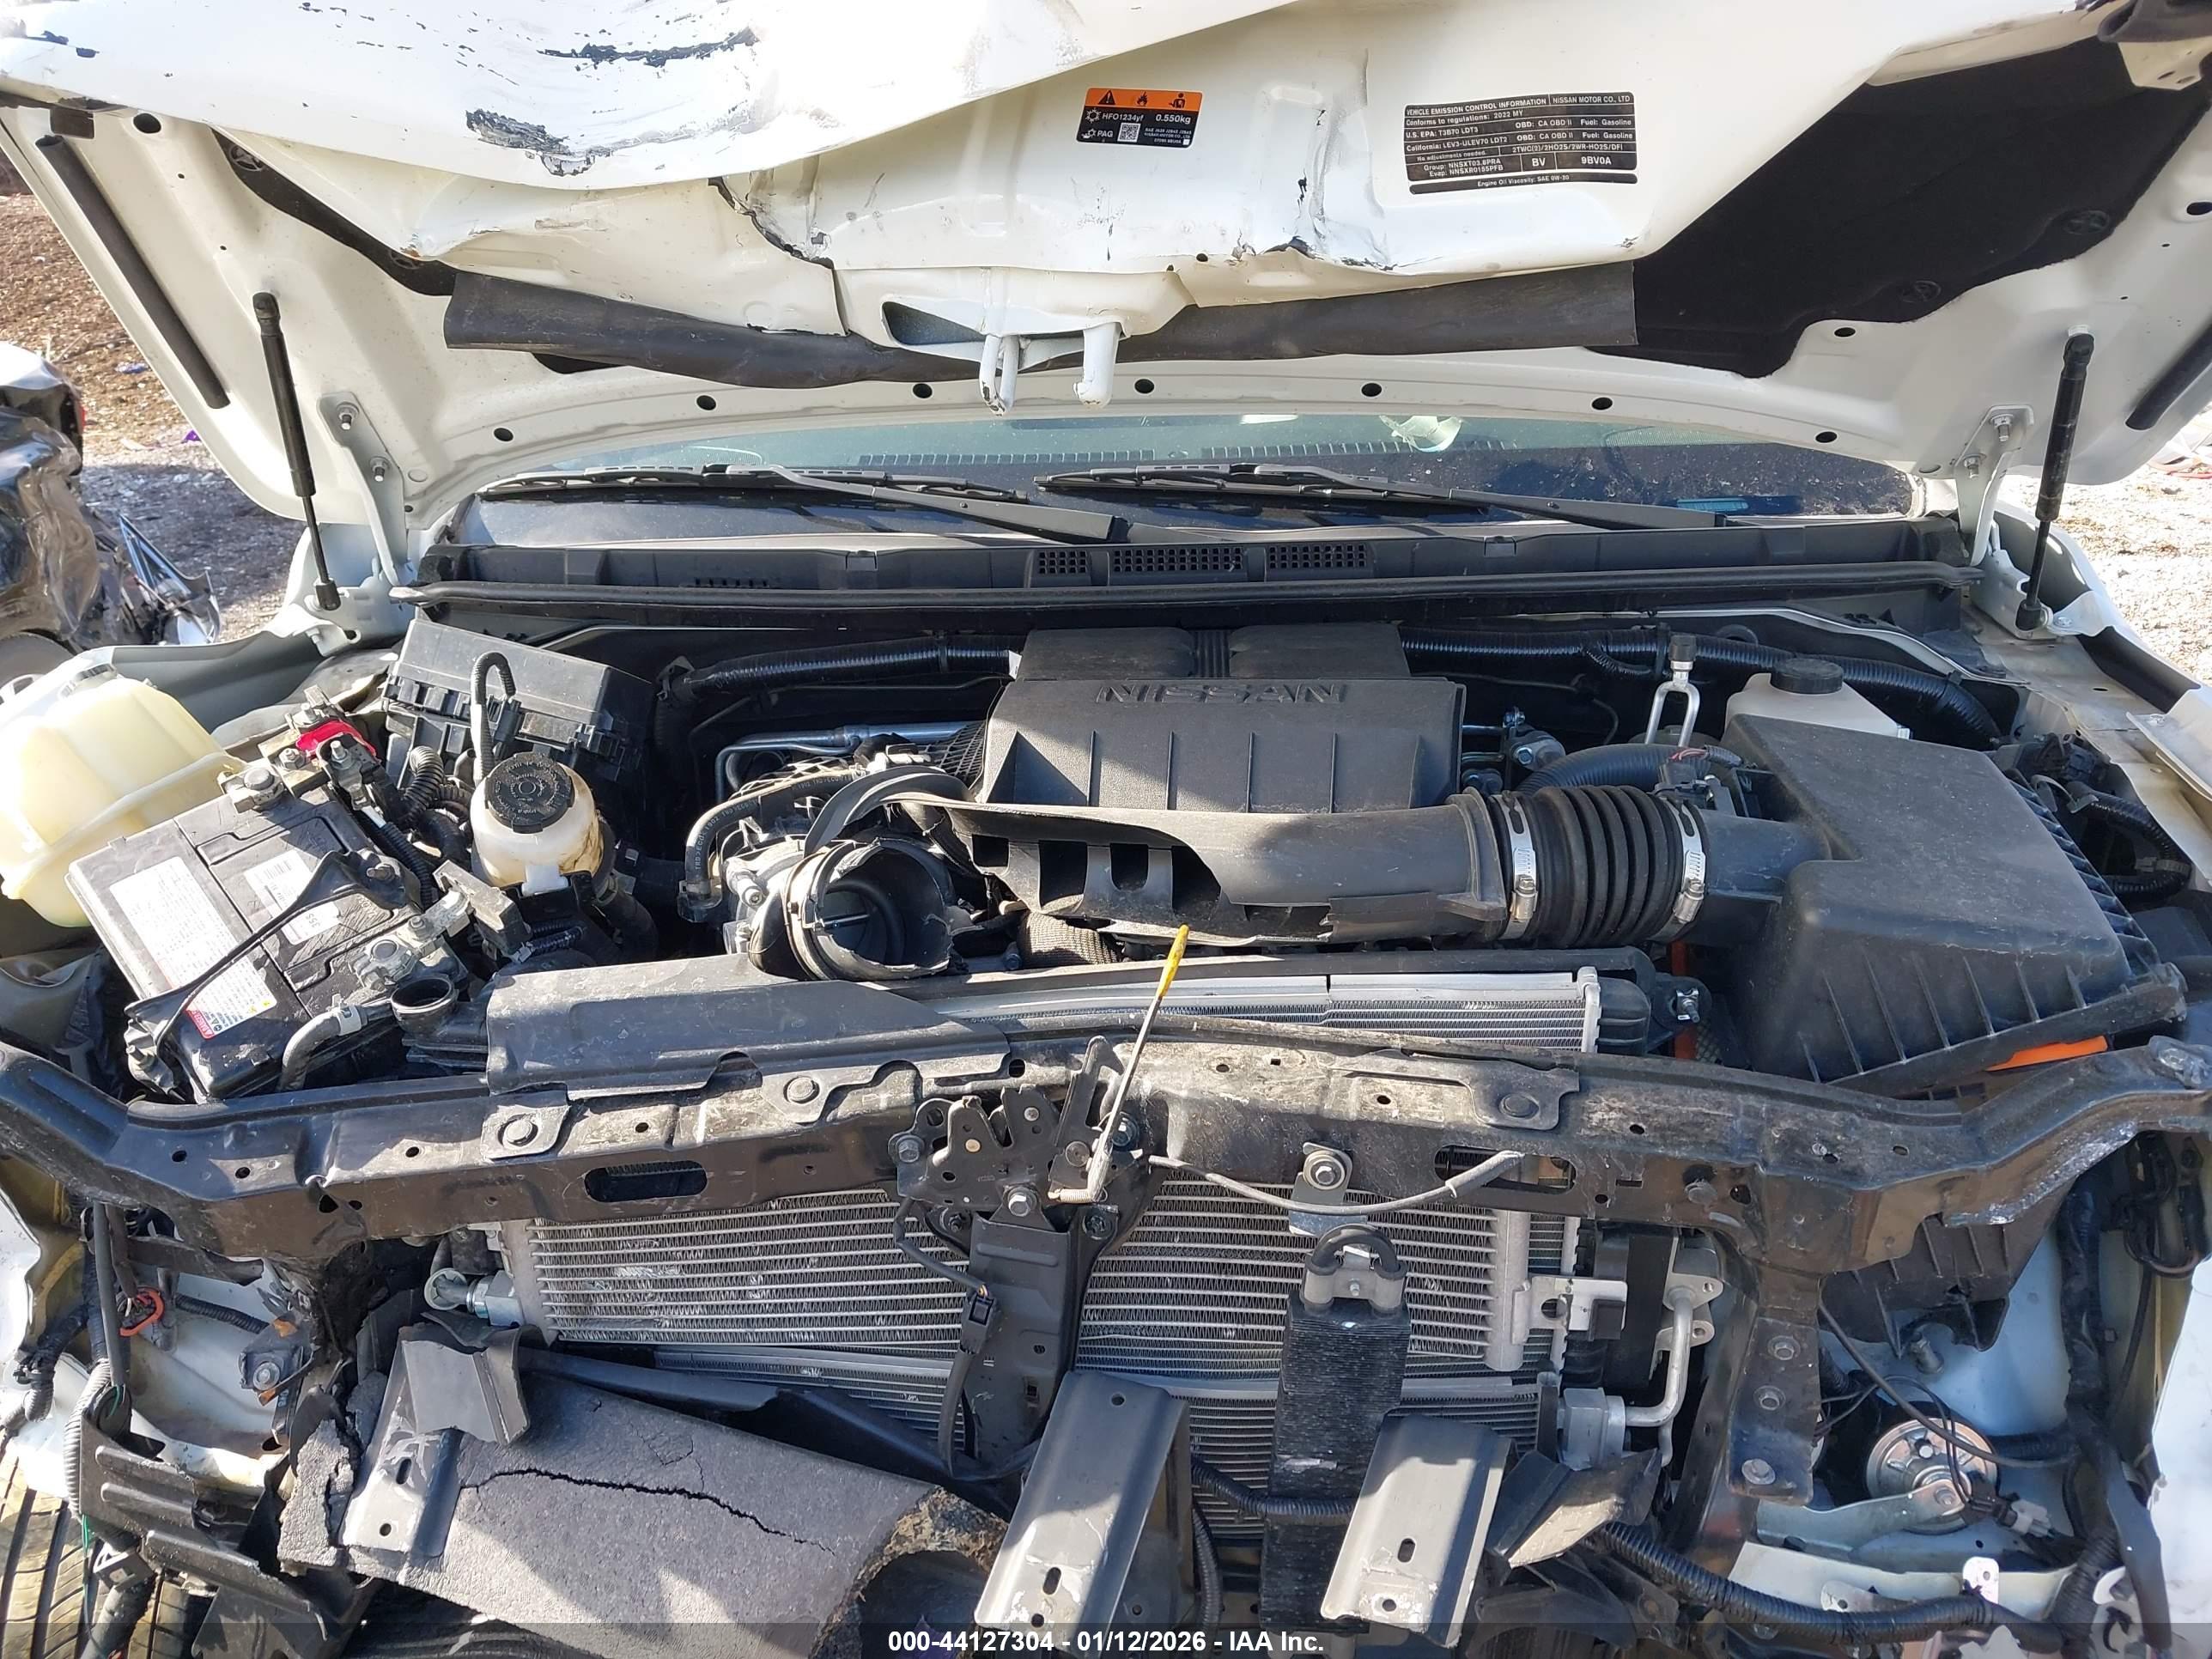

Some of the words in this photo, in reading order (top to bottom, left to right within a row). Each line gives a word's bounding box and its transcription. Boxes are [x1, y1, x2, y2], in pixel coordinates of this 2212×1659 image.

[1431, 106, 1463, 115] EMISSION
[1465, 103, 1497, 112] CONTROL
[1499, 98, 1546, 108] INFORMATION
[1102, 113, 1143, 122] HFO1234yf
[1156, 114, 1191, 124] 0.550kg
[1447, 114, 1490, 124] regulations:
[1443, 138, 1488, 148] LEV3-ULEV70
[1532, 158, 1545, 166] BV
[1095, 684, 1346, 703] NISSAN
